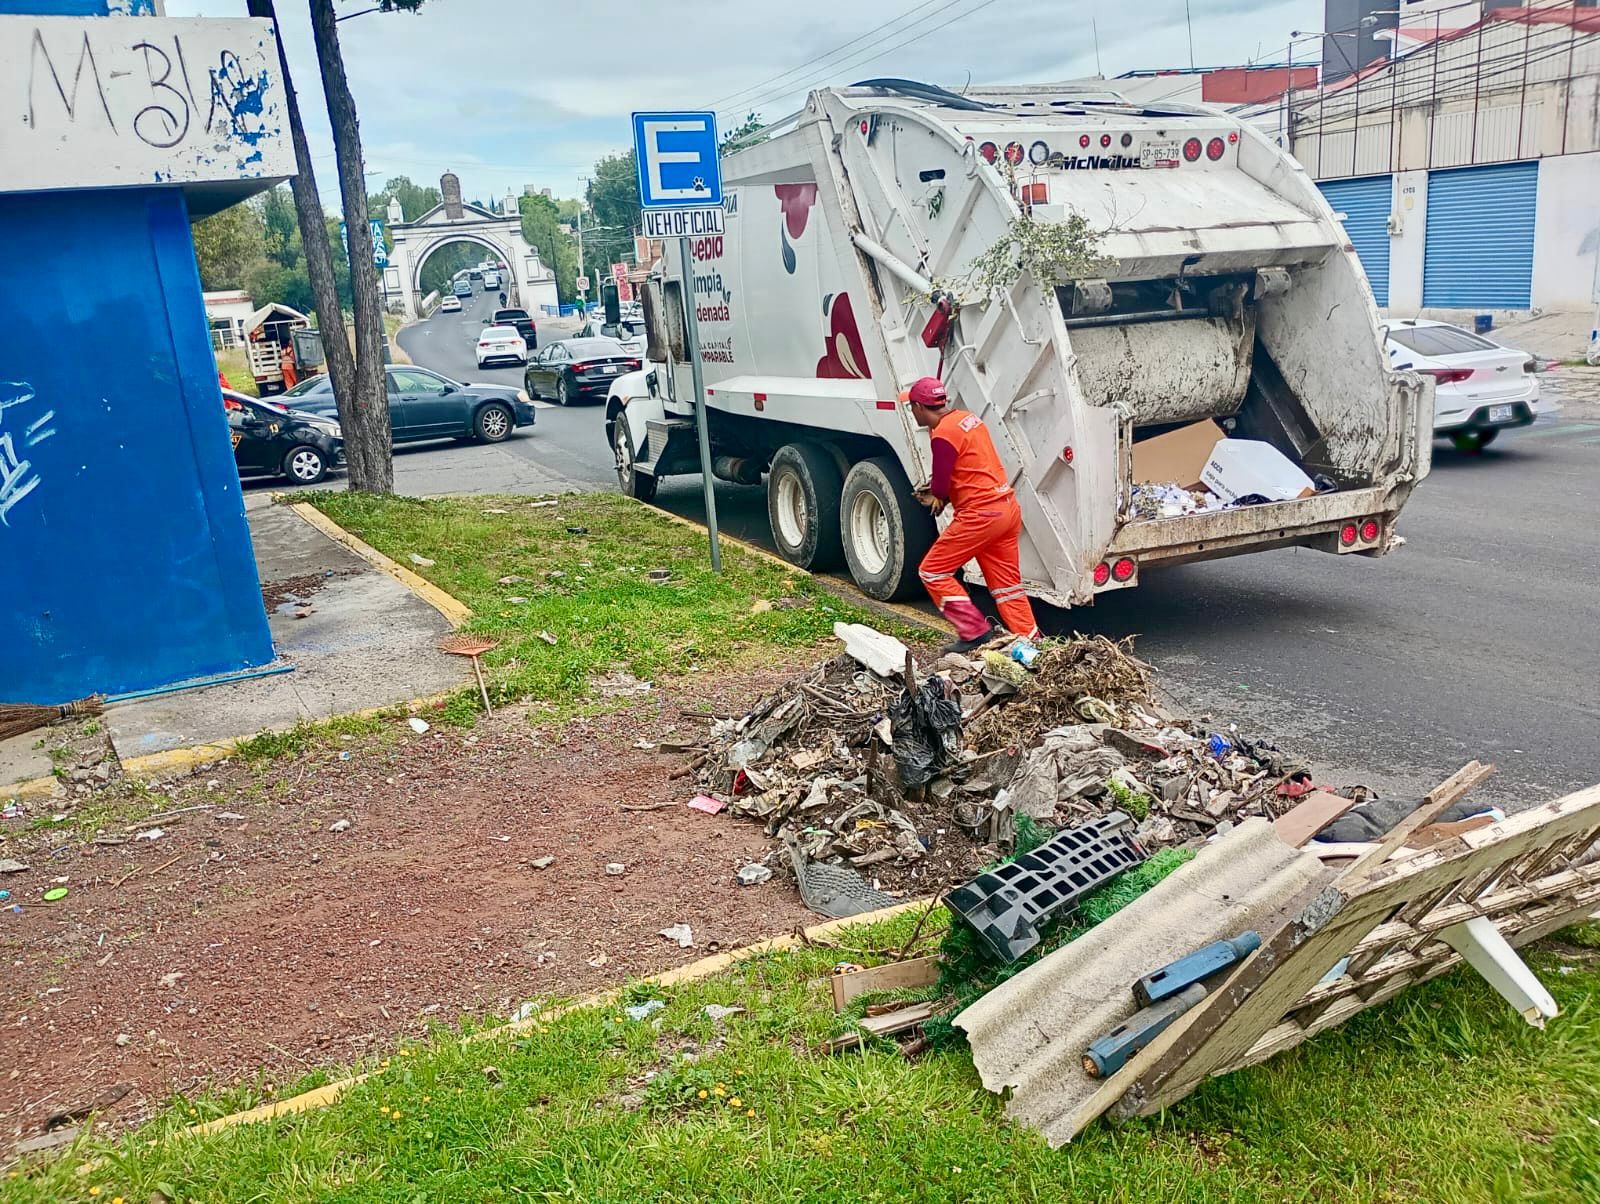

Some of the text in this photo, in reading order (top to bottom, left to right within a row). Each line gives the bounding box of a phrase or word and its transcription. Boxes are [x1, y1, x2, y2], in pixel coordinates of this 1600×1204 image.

[643, 120, 713, 200] E
[646, 210, 722, 235] VEH OFICIAL
[693, 267, 722, 298] impia
[696, 301, 730, 322] denada
